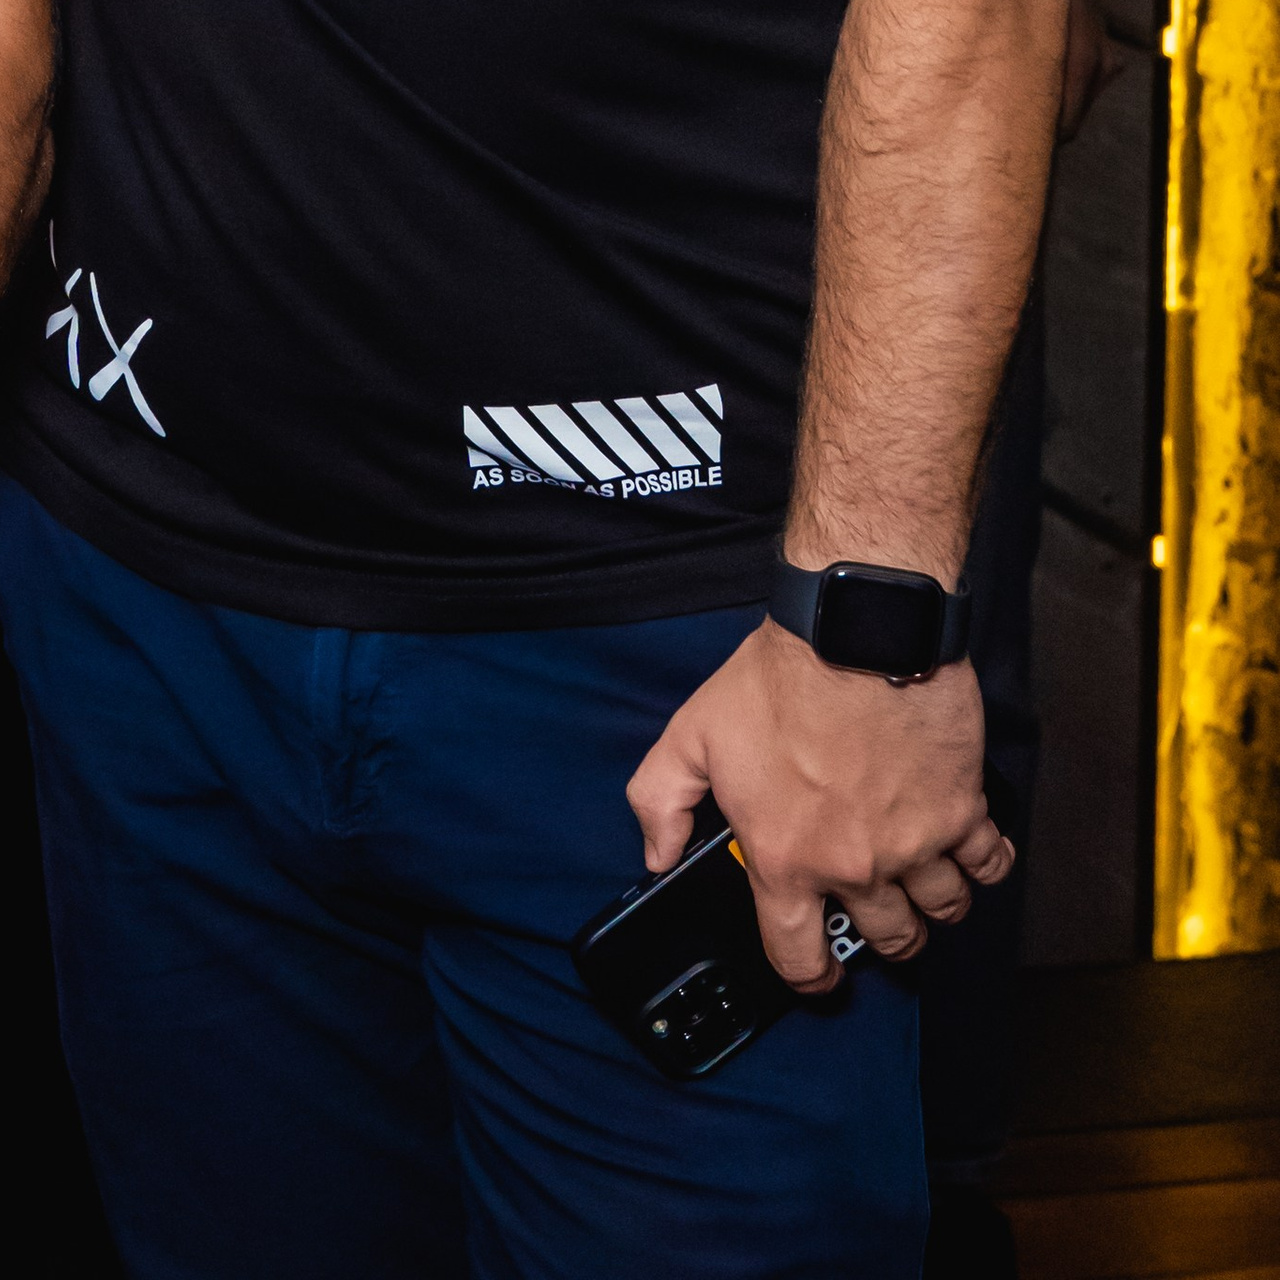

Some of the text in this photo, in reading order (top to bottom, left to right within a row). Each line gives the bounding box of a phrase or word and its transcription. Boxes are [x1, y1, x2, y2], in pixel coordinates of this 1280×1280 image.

[473, 467, 504, 490] AS
[584, 483, 615, 498] AS
[622, 466, 723, 499] POSSIBLE
